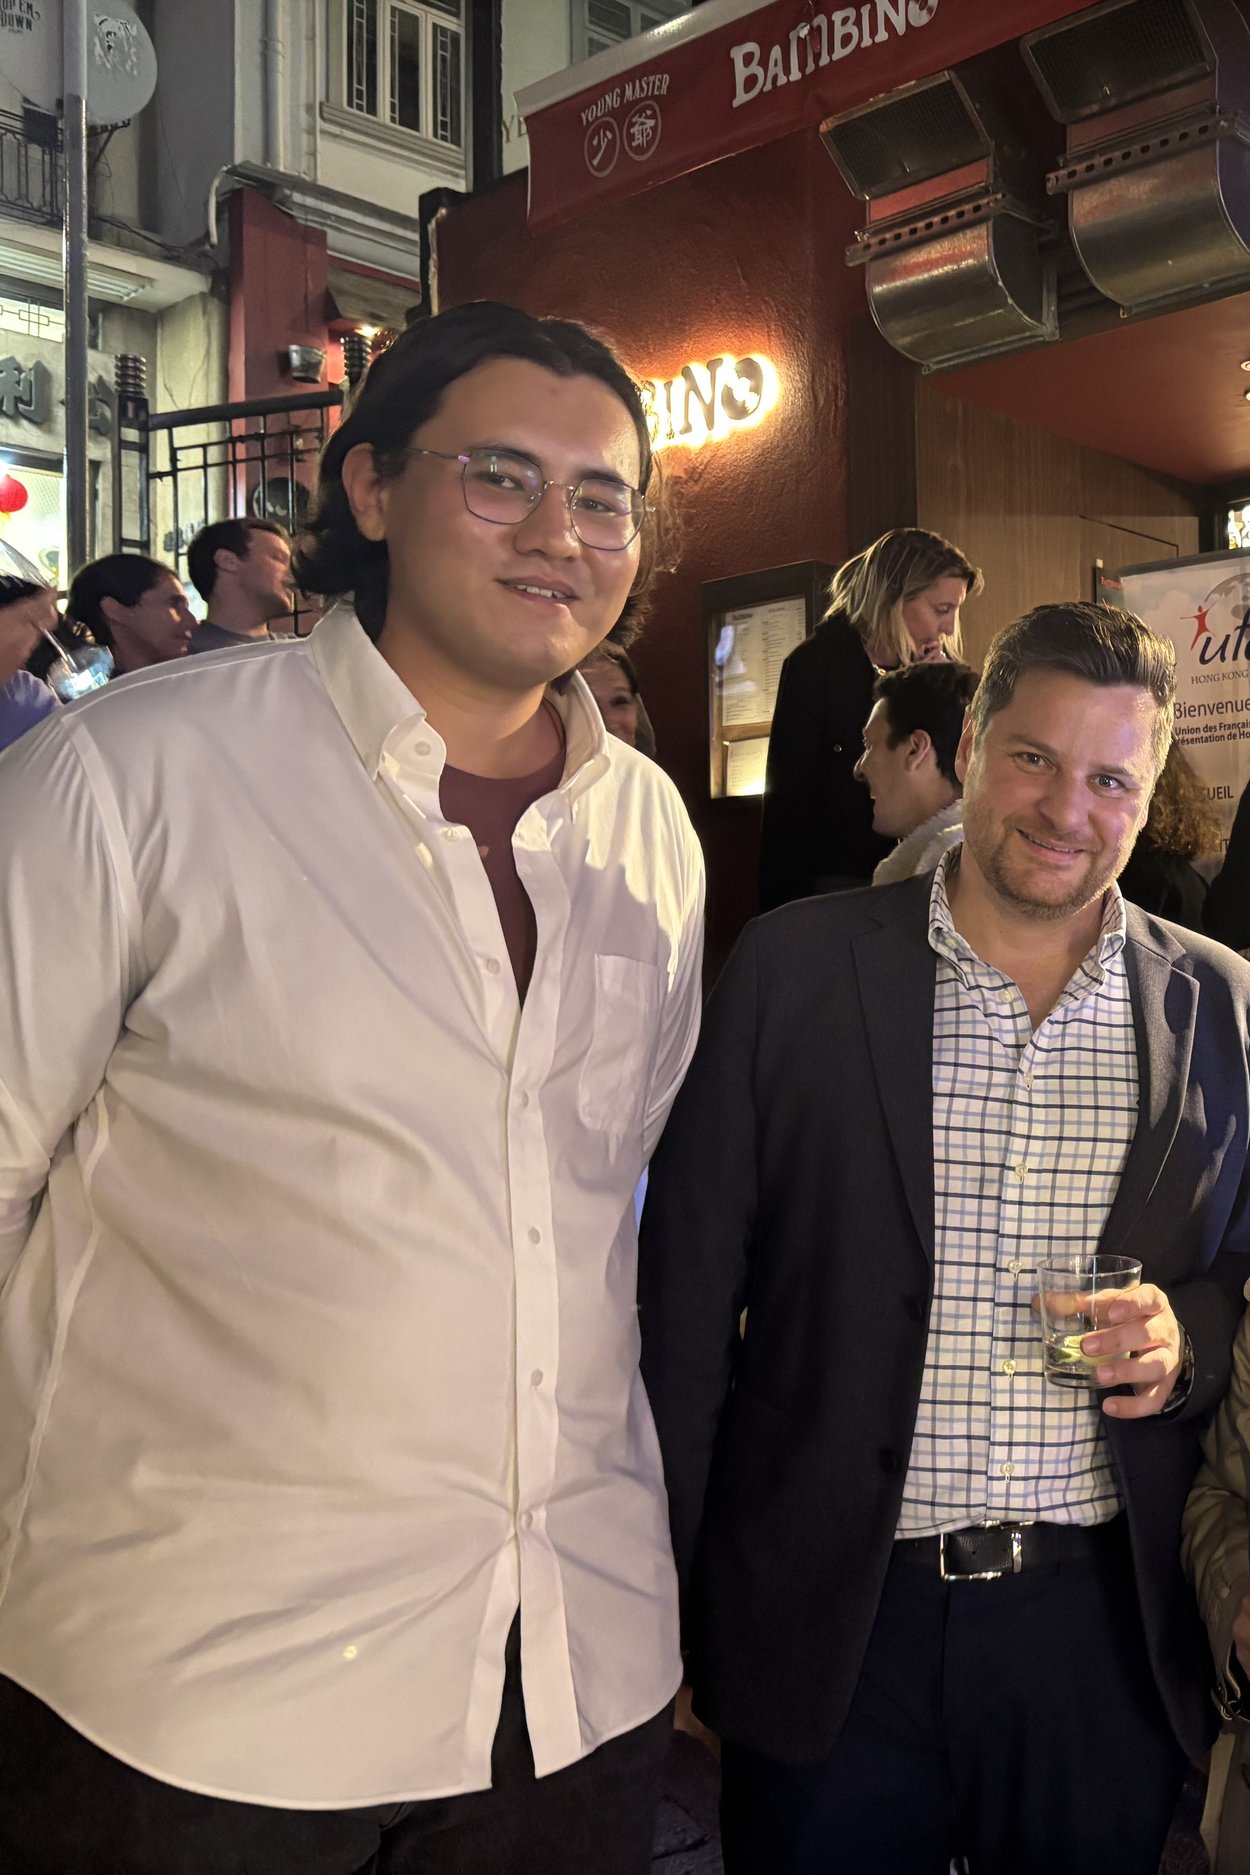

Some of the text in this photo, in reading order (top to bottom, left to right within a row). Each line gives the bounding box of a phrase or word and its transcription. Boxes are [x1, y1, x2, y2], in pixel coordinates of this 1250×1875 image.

[730, 0, 938, 108] BAMBINO
[580, 73, 670, 126] YOUNG MASTER
[1191, 672, 1220, 685] HONG
[1221, 668, 1249, 682] KONG
[1175, 727, 1200, 736] Union
[1202, 723, 1218, 734] des
[1226, 729, 1238, 740] de
[1203, 786, 1234, 800] UEIL
